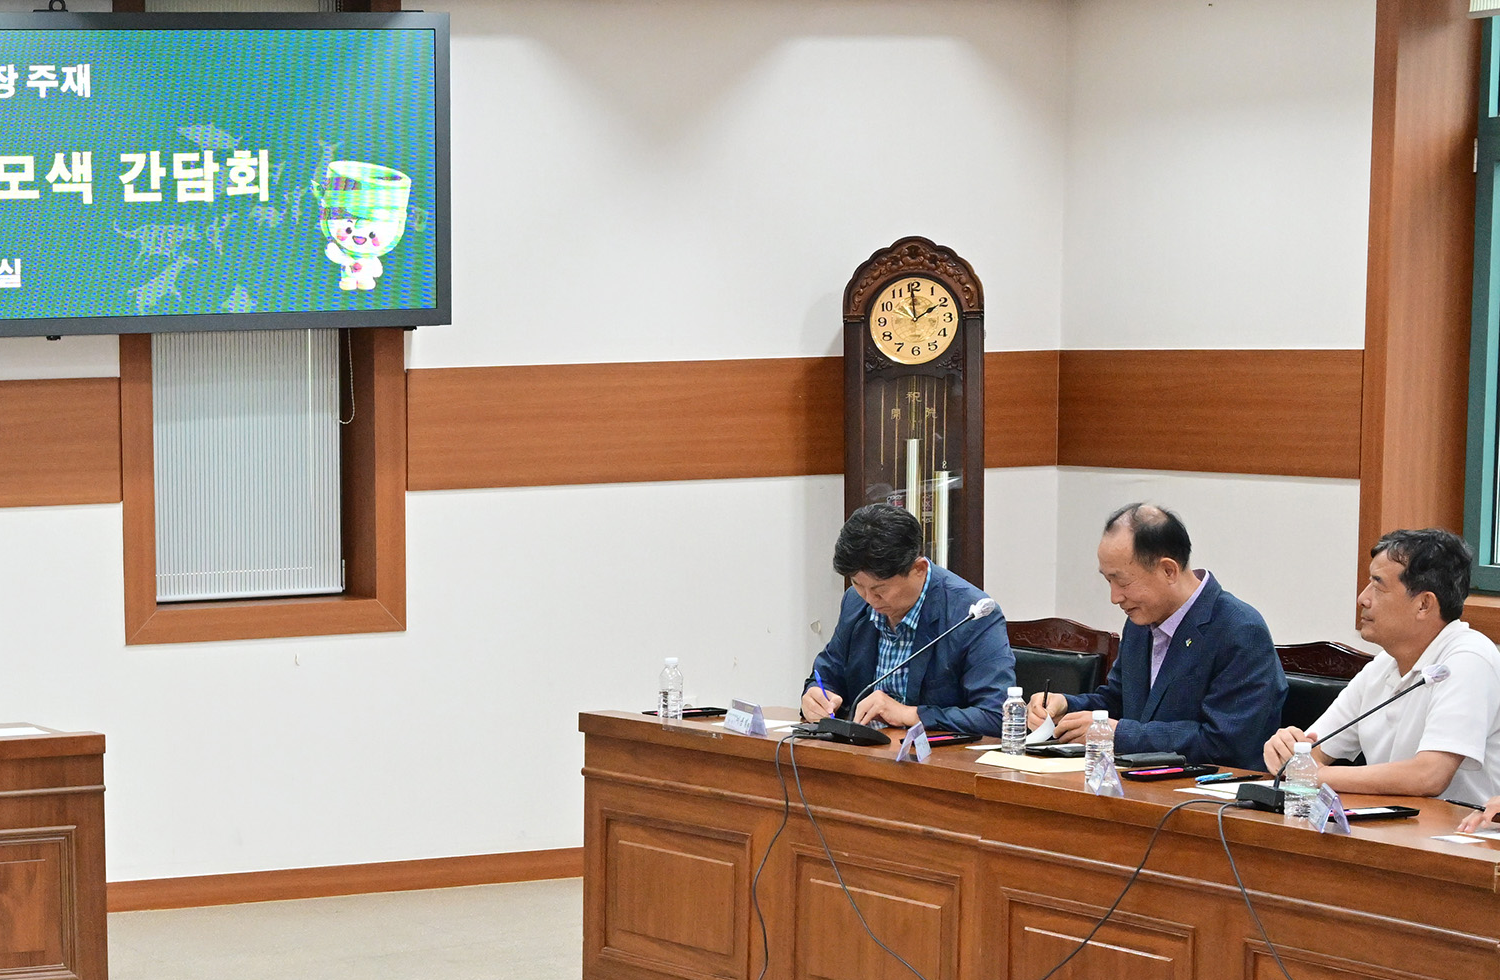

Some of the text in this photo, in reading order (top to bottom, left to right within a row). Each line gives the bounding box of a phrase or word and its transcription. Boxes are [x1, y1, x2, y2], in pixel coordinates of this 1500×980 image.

[26, 63, 91, 99] 주재
[119, 149, 270, 203] 간담회
[907, 281, 921, 293] 12
[891, 288, 903, 299] 11
[881, 301, 893, 312] 10
[939, 297, 948, 308] 2
[878, 317, 887, 327] 9
[943, 312, 953, 323] 3
[882, 331, 892, 341] 8
[938, 328, 947, 337] 4
[895, 342, 904, 352] 7
[911, 346, 921, 356] 6
[928, 341, 938, 351] 5
